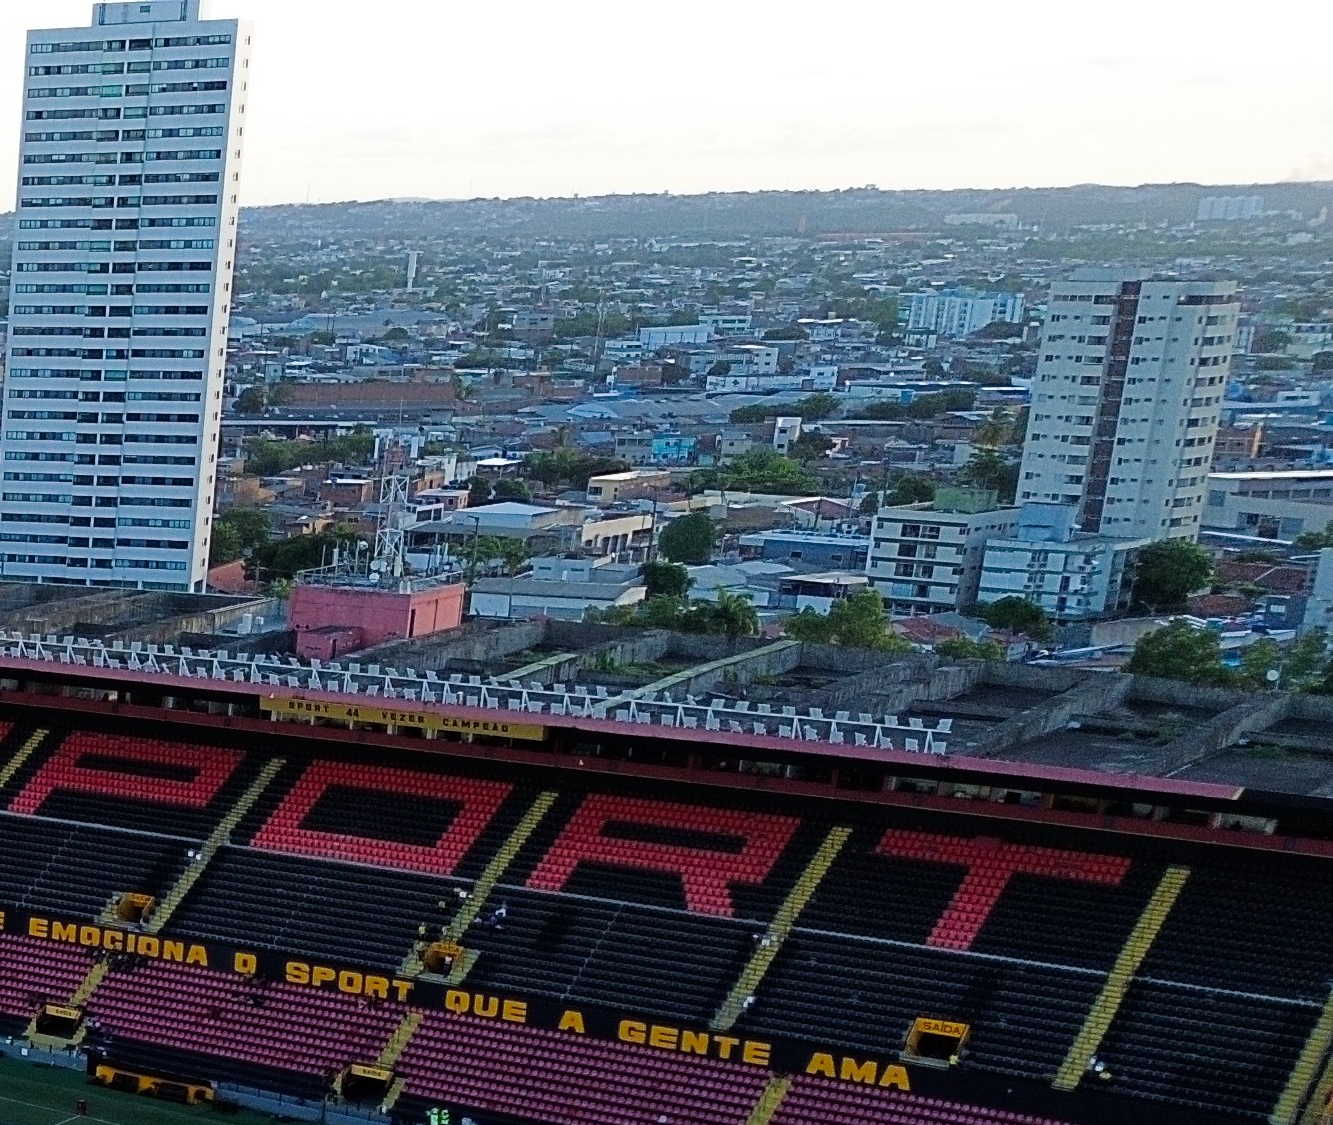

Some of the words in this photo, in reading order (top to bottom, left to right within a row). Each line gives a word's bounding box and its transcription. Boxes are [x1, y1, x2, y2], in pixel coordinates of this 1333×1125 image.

[288, 701, 330, 713] SPORT
[345, 708, 360, 718] 44
[29, 917, 208, 966] EMOCIONA
[234, 951, 257, 974] O
[285, 961, 415, 1002] SPORT
[445, 989, 528, 1024] QUE
[558, 1010, 585, 1034] A
[617, 1018, 772, 1067] GENTE
[805, 1052, 911, 1091] AMA
[923, 1019, 961, 1036] SAÍDA
